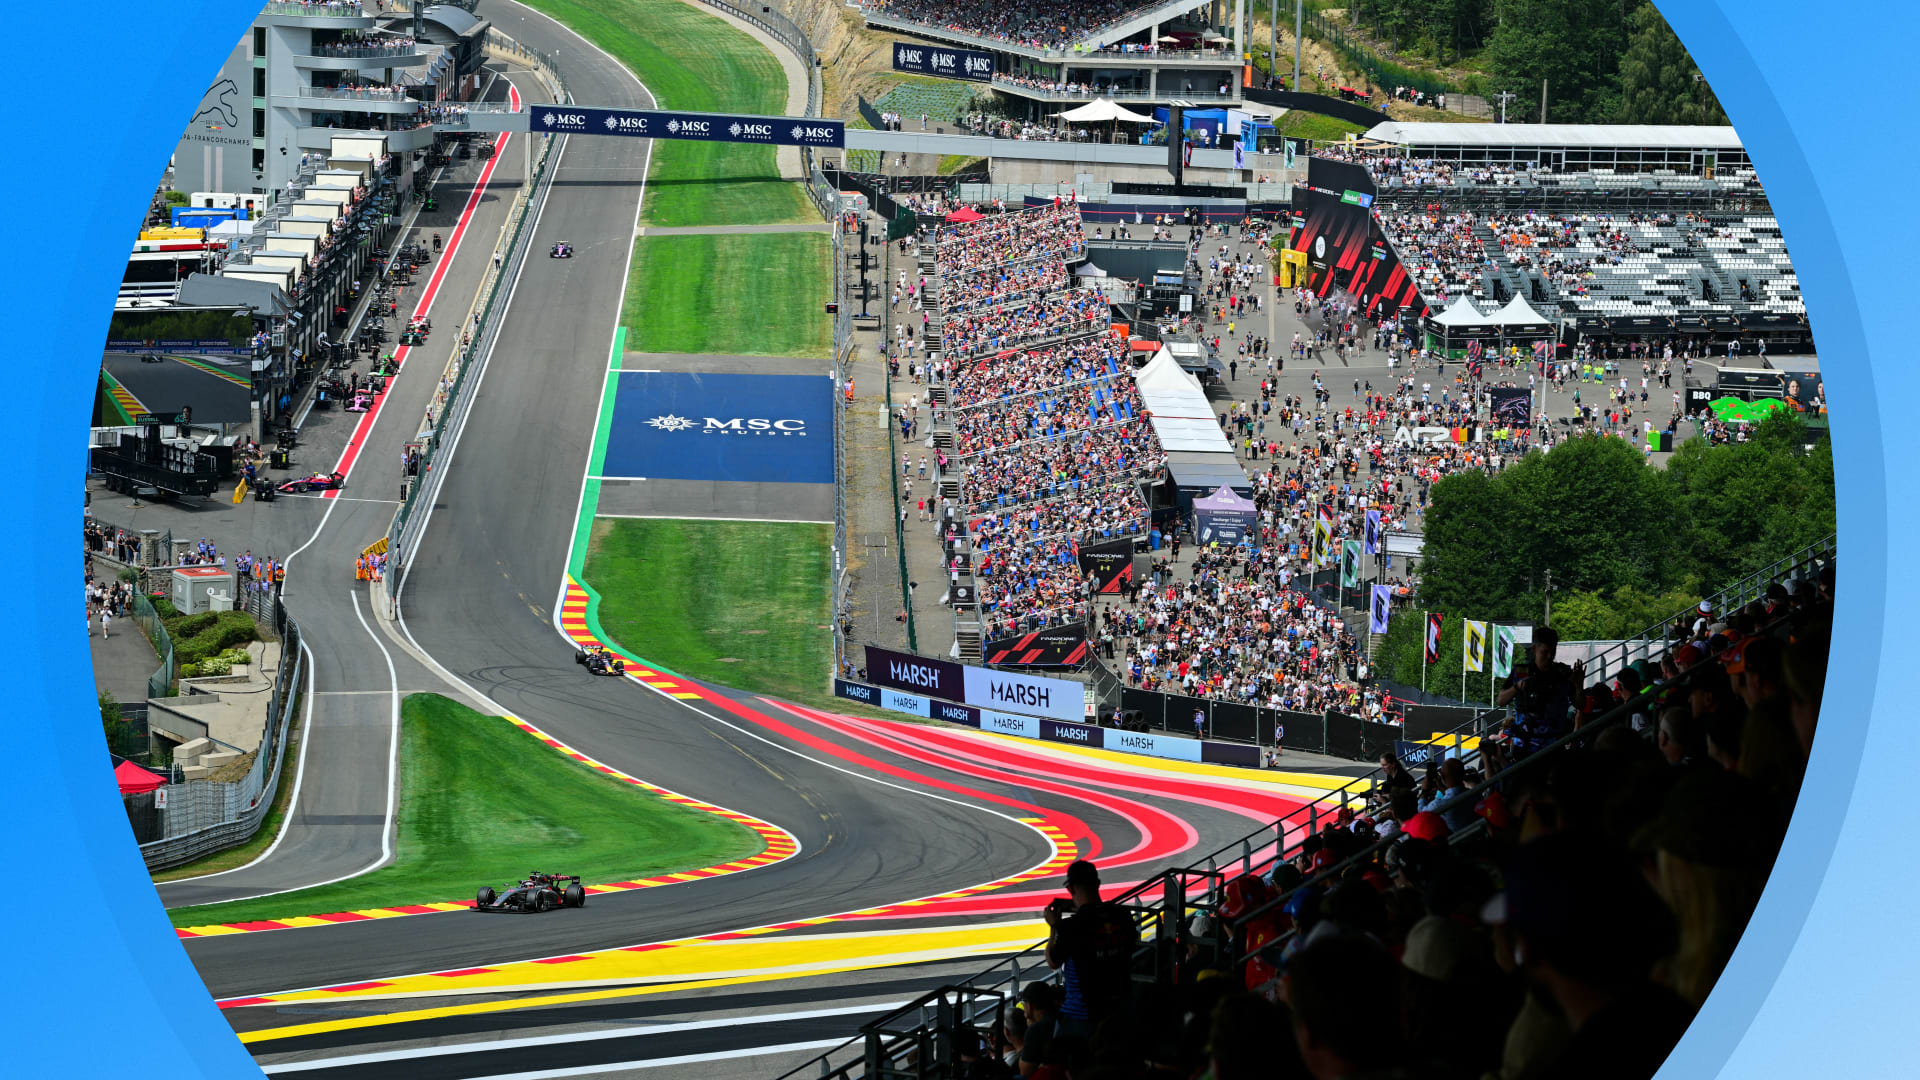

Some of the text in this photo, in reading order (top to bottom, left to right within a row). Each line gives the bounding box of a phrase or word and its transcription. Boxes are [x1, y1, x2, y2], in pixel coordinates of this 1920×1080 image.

[906, 50, 922, 63] MSC
[939, 54, 955, 67] MSC
[973, 58, 990, 71] MSC
[557, 114, 585, 125] MSC
[620, 117, 647, 128] MSC
[681, 121, 710, 132] MSC
[743, 124, 772, 135] MSC
[805, 127, 834, 138] MSC
[181, 134, 250, 145] PA-FRANCORCHAMPS
[1692, 391, 1711, 400] BBQ
[702, 417, 806, 431] MSC
[702, 429, 807, 437] CRUISES
[890, 659, 939, 689] MARSH
[846, 685, 870, 700] MARSH
[990, 679, 1050, 709] MARSH
[893, 696, 918, 710] MARSH
[942, 705, 969, 721] MARSH
[993, 717, 1024, 732] MARSH
[1055, 726, 1088, 741] MARSH
[1121, 735, 1154, 750] MARSH
